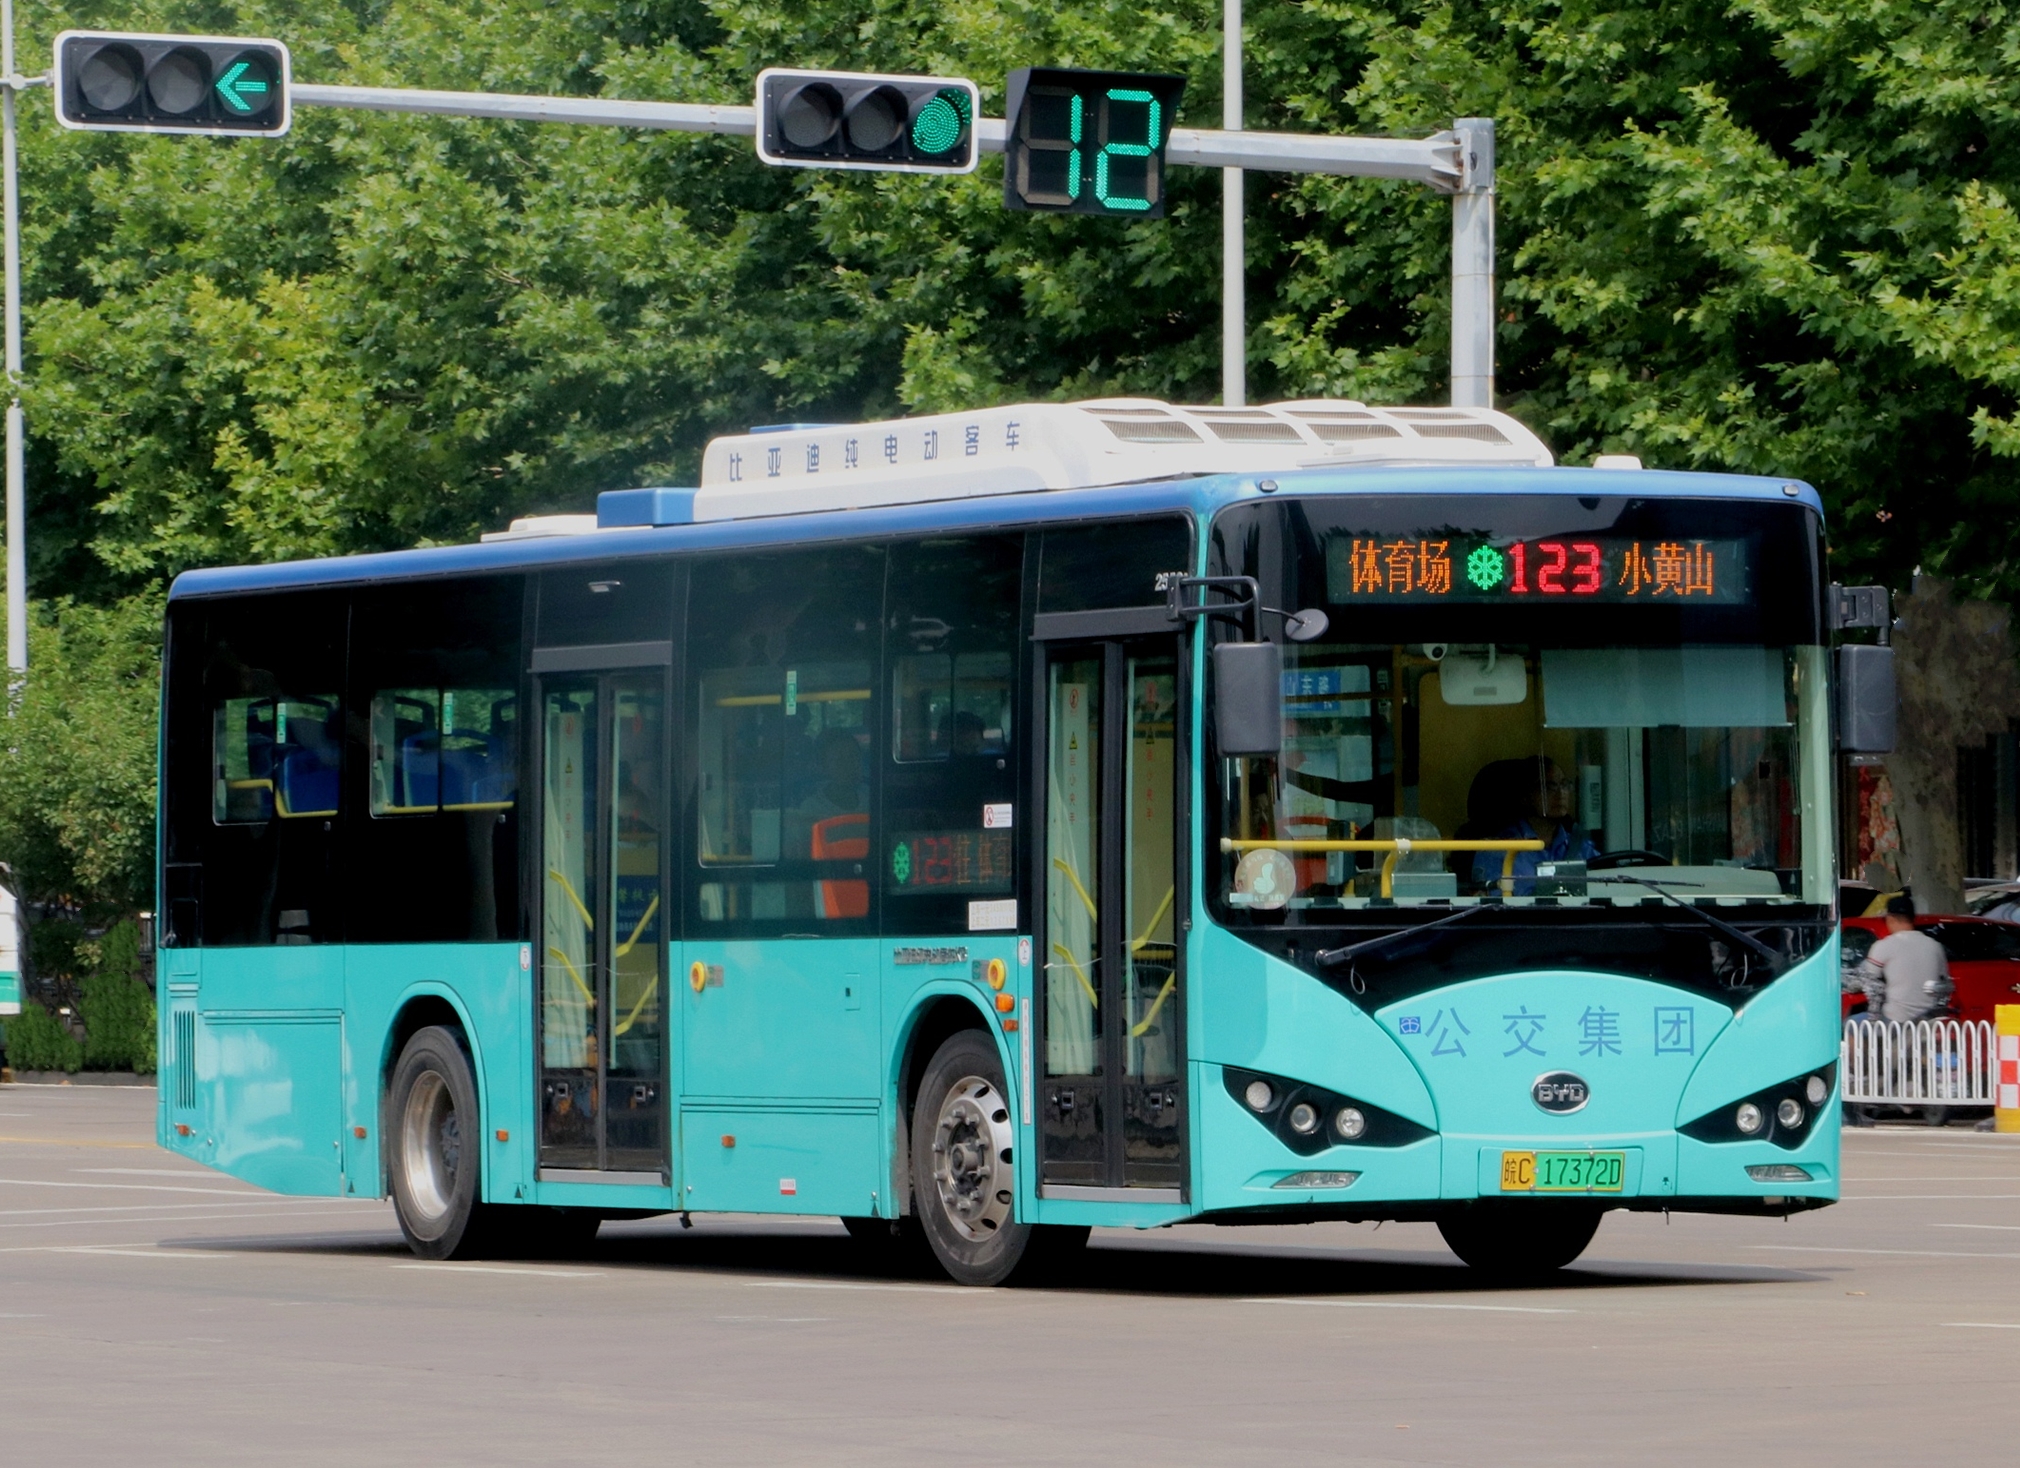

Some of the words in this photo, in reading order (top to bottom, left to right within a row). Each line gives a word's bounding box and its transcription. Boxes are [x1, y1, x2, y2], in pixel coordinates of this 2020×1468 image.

[1068, 88, 1161, 210] 12
[729, 421, 1020, 482] 比亚迪纯电动客车
[1349, 539, 1451, 593] 体育场
[1509, 543, 1602, 593] 123
[1618, 542, 1713, 596] 小黄山
[1424, 1005, 1695, 1057] 公交集团
[1538, 1083, 1584, 1102] BYD
[1544, 1158, 1621, 1185] 17372D
